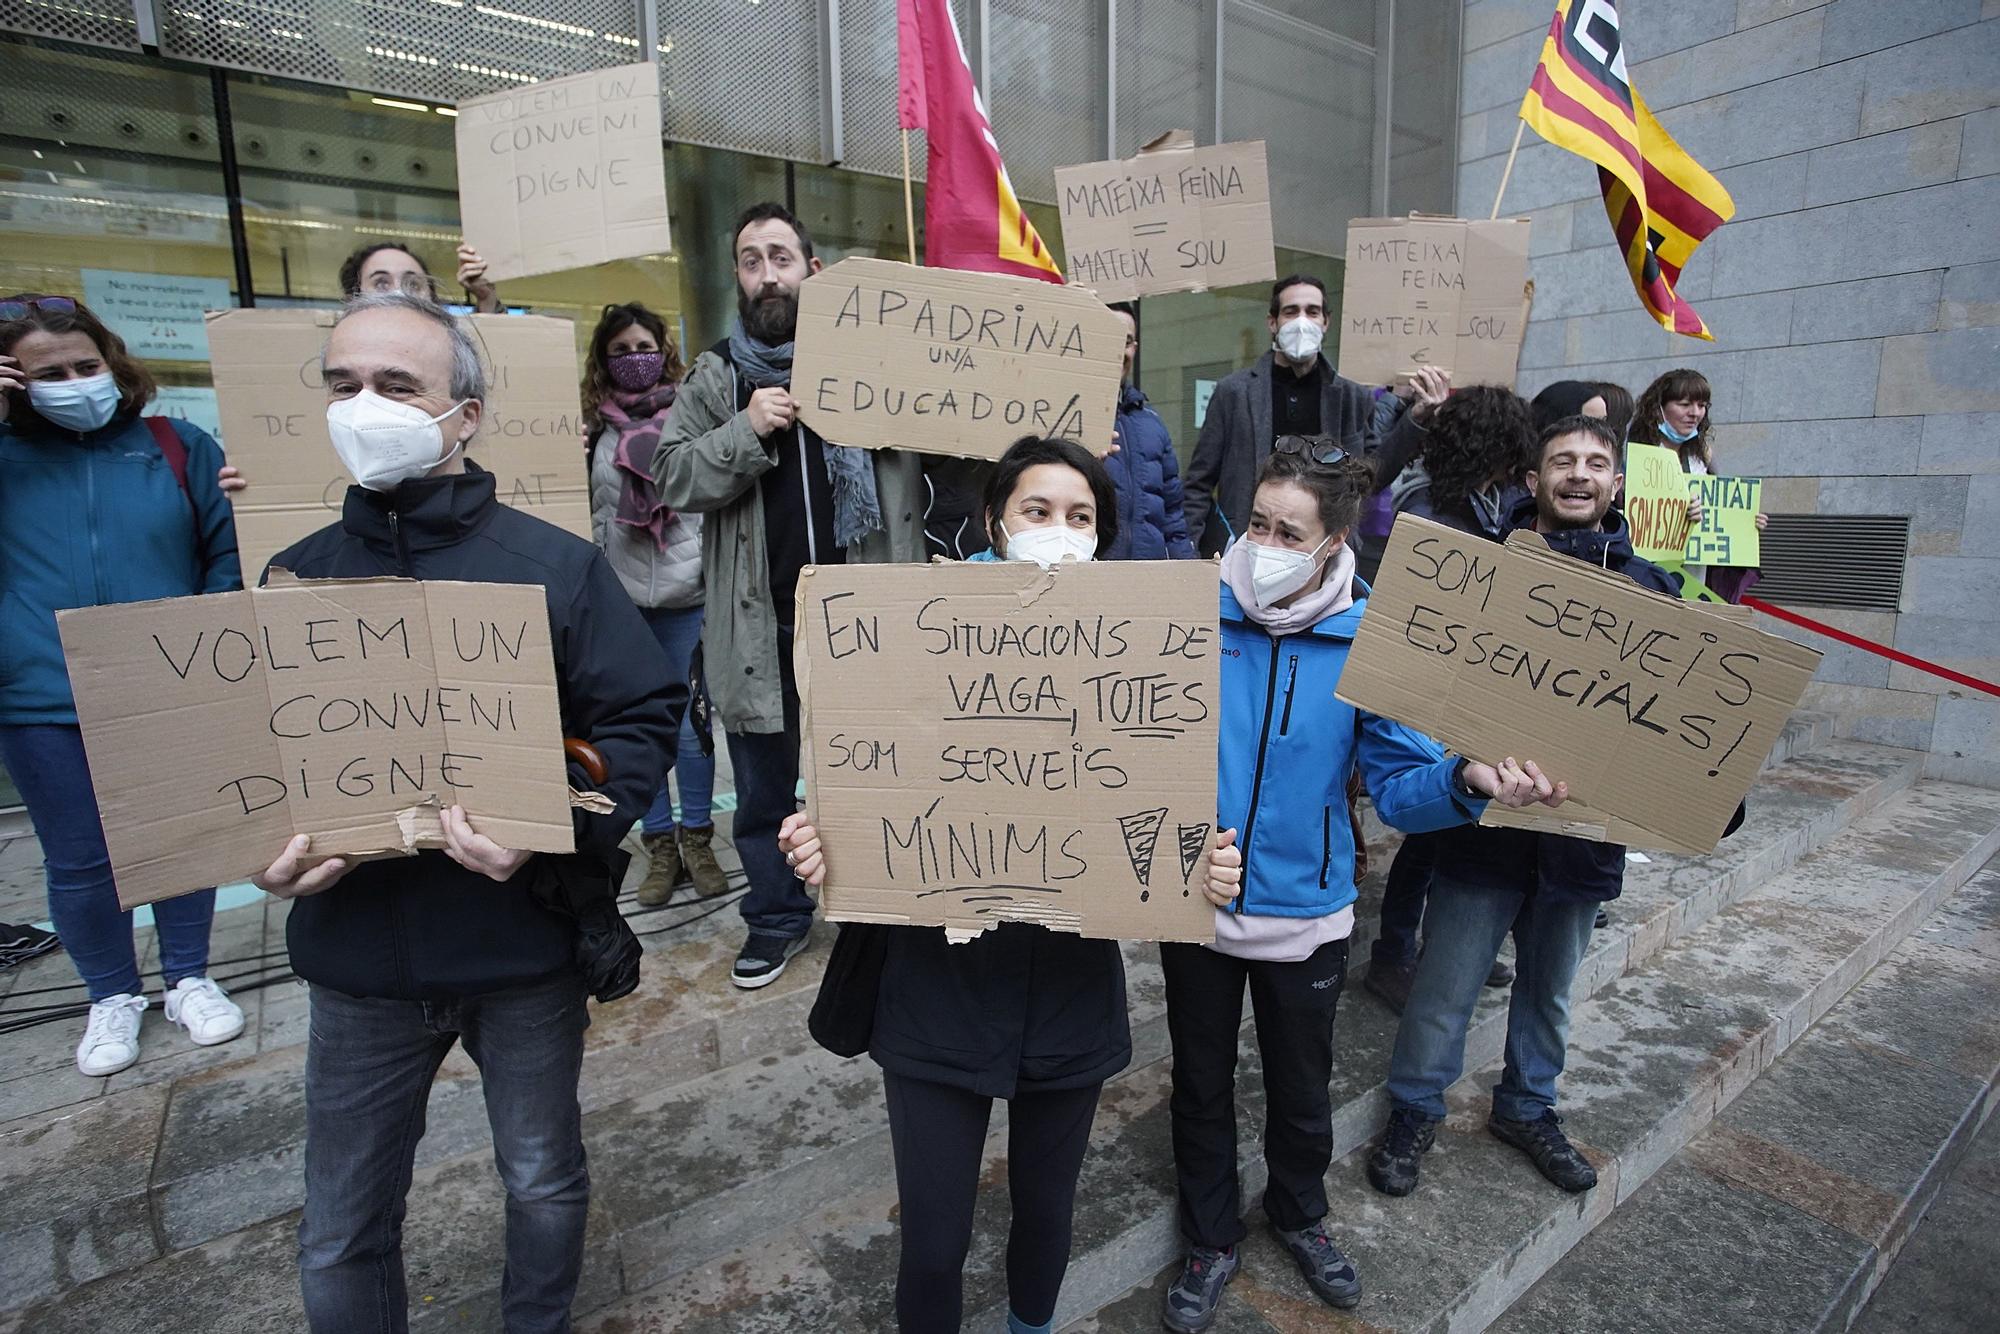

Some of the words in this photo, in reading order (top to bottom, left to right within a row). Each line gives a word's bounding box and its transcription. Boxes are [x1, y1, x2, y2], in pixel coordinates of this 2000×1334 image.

[598, 76, 637, 101] UN
[1177, 240, 1226, 268] SOU
[1456, 315, 1506, 340] SOU
[929, 346, 977, 374] UN/A
[253, 414, 306, 438] DE
[817, 377, 1084, 440] EDUCADOR/A
[1629, 495, 1653, 549] SOM
[1405, 538, 1497, 612] SOM
[152, 617, 411, 683] VOLEM
[451, 615, 528, 664] UN
[821, 591, 880, 660] EN
[1159, 621, 1212, 660] DE
[947, 672, 1078, 737] VAGA,
[1082, 670, 1209, 724] TOTES
[827, 733, 899, 777] SOM
